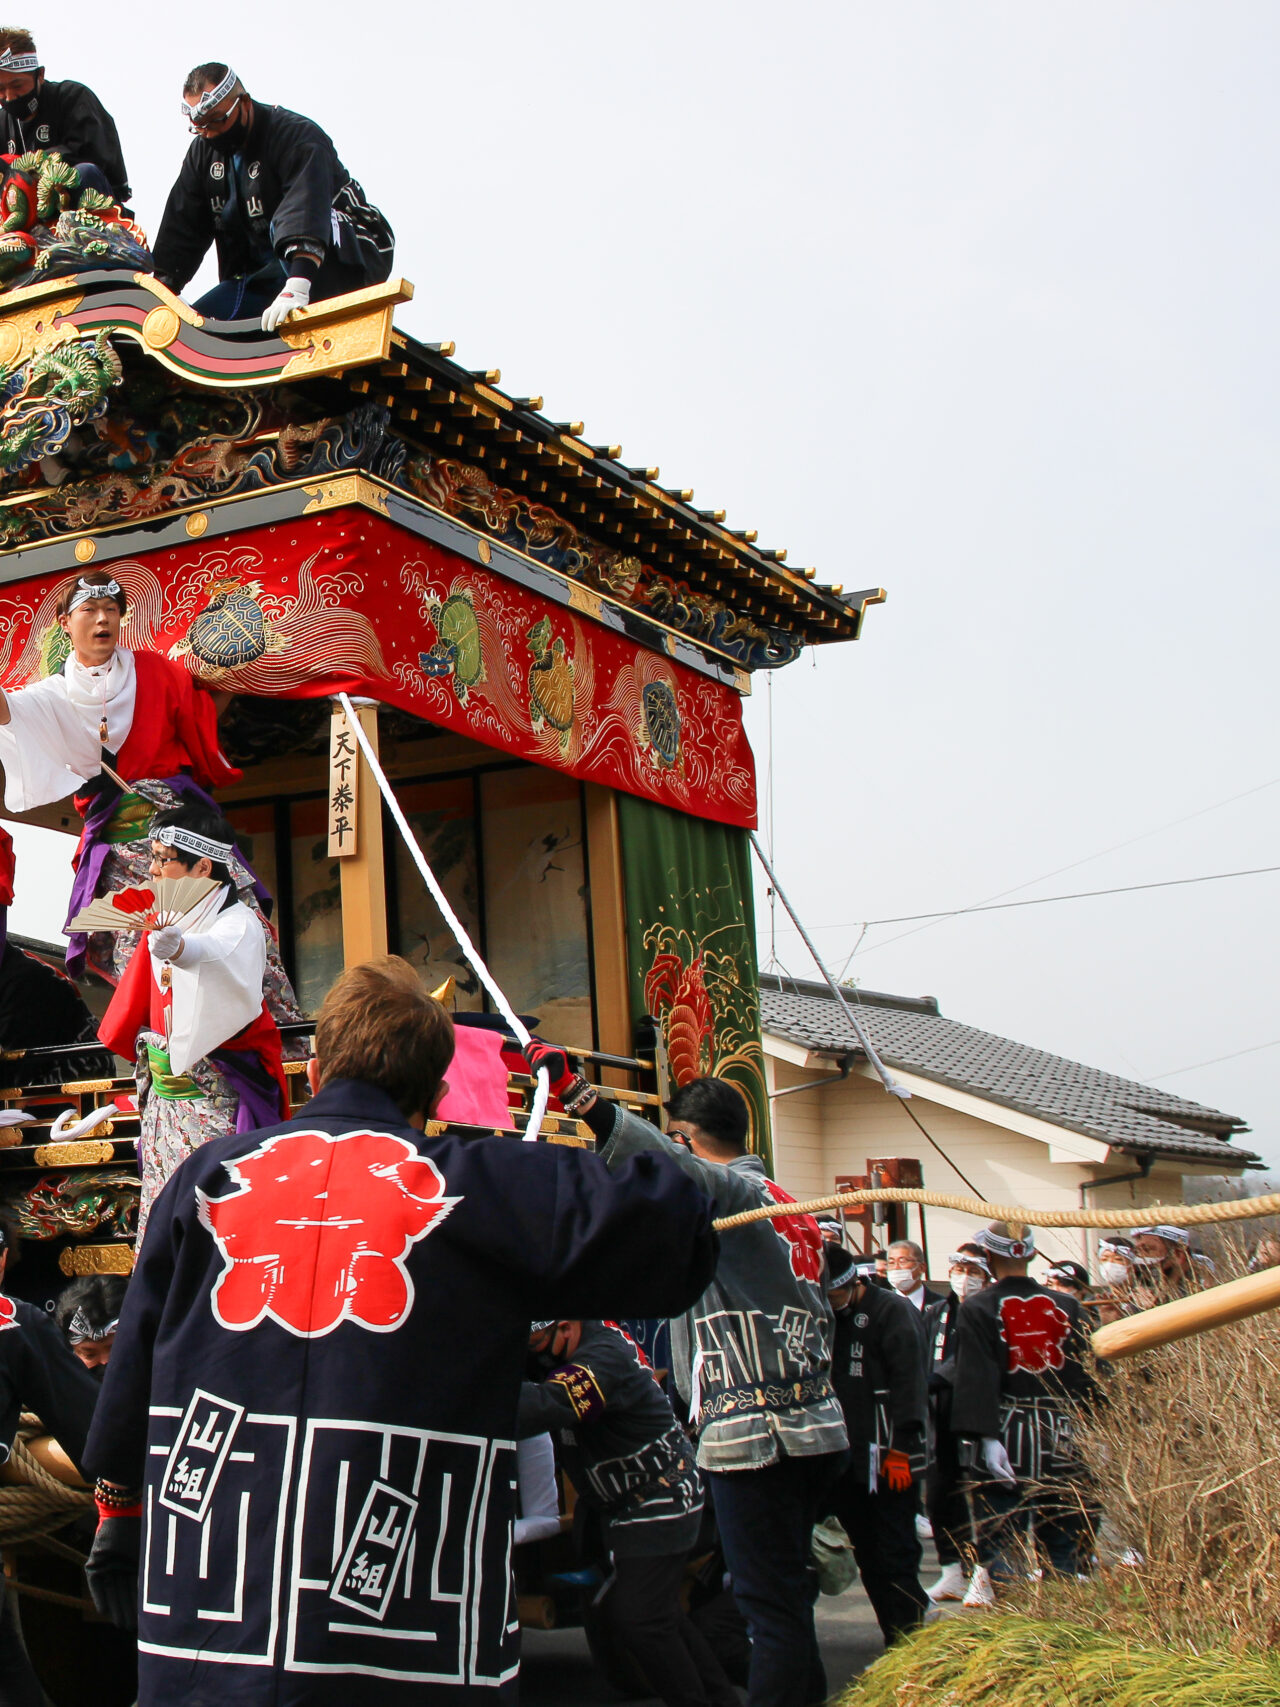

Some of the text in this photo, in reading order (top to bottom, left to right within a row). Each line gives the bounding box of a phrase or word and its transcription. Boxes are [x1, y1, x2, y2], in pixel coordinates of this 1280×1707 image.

[331, 731, 355, 848] 天下泰平
[849, 1341, 864, 1377] 山組
[169, 1411, 224, 1501] 山組
[345, 1505, 402, 1598] 山組
